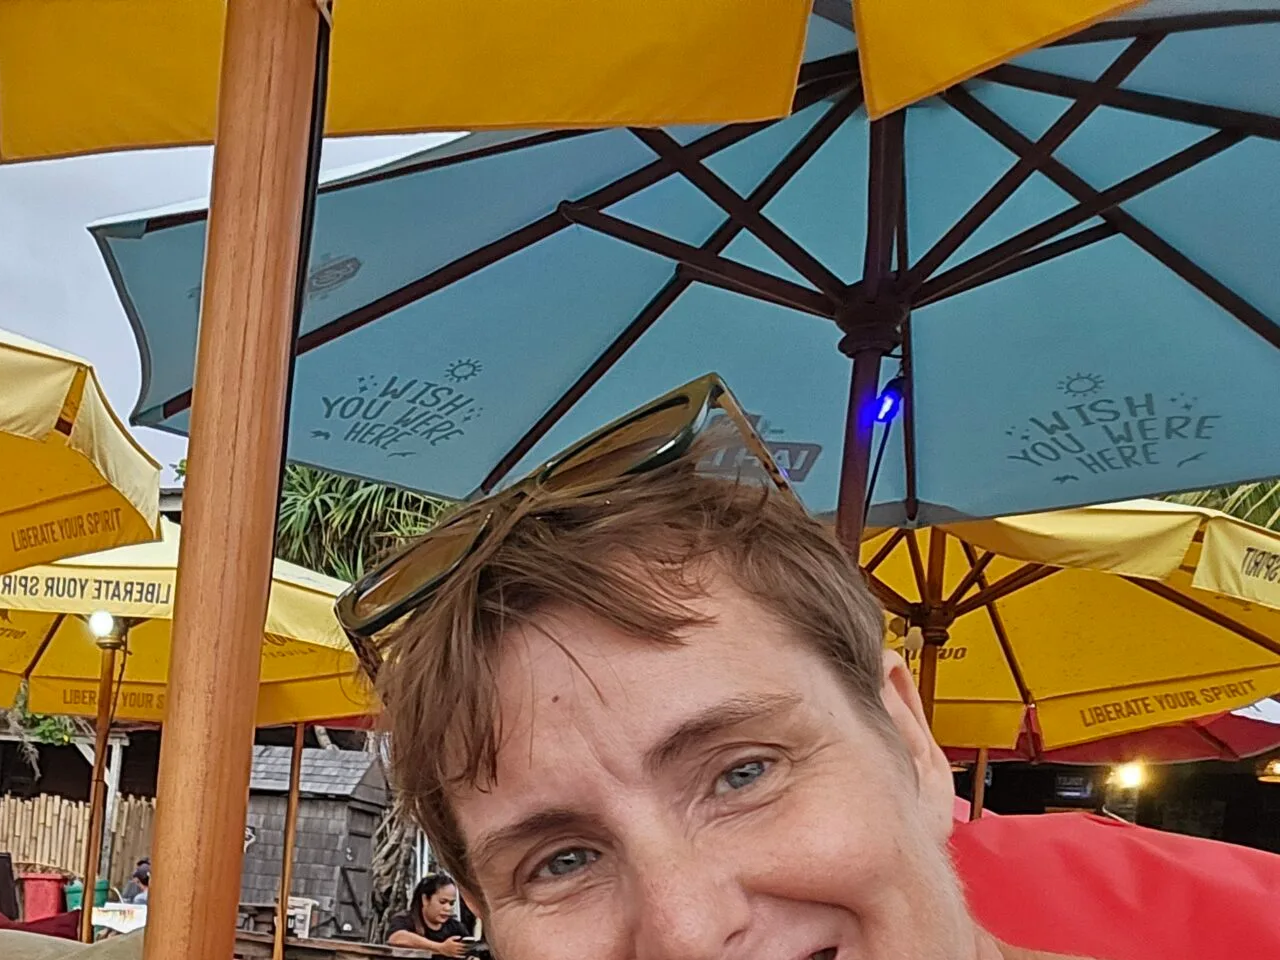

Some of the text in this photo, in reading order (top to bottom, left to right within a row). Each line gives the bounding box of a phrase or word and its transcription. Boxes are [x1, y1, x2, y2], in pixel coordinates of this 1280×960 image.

[379, 376, 475, 416] WISH
[1028, 392, 1155, 435] WISH
[322, 396, 465, 446] YOU WERE
[344, 421, 412, 450] HERE
[1007, 415, 1222, 467] YOU WERE
[1076, 442, 1160, 474] HERE
[11, 508, 122, 552] LIBERATE YOUR SPIRIT
[121, 691, 153, 709] YOUR
[1079, 679, 1257, 728] LIBERATE YOUR SPIRIT
